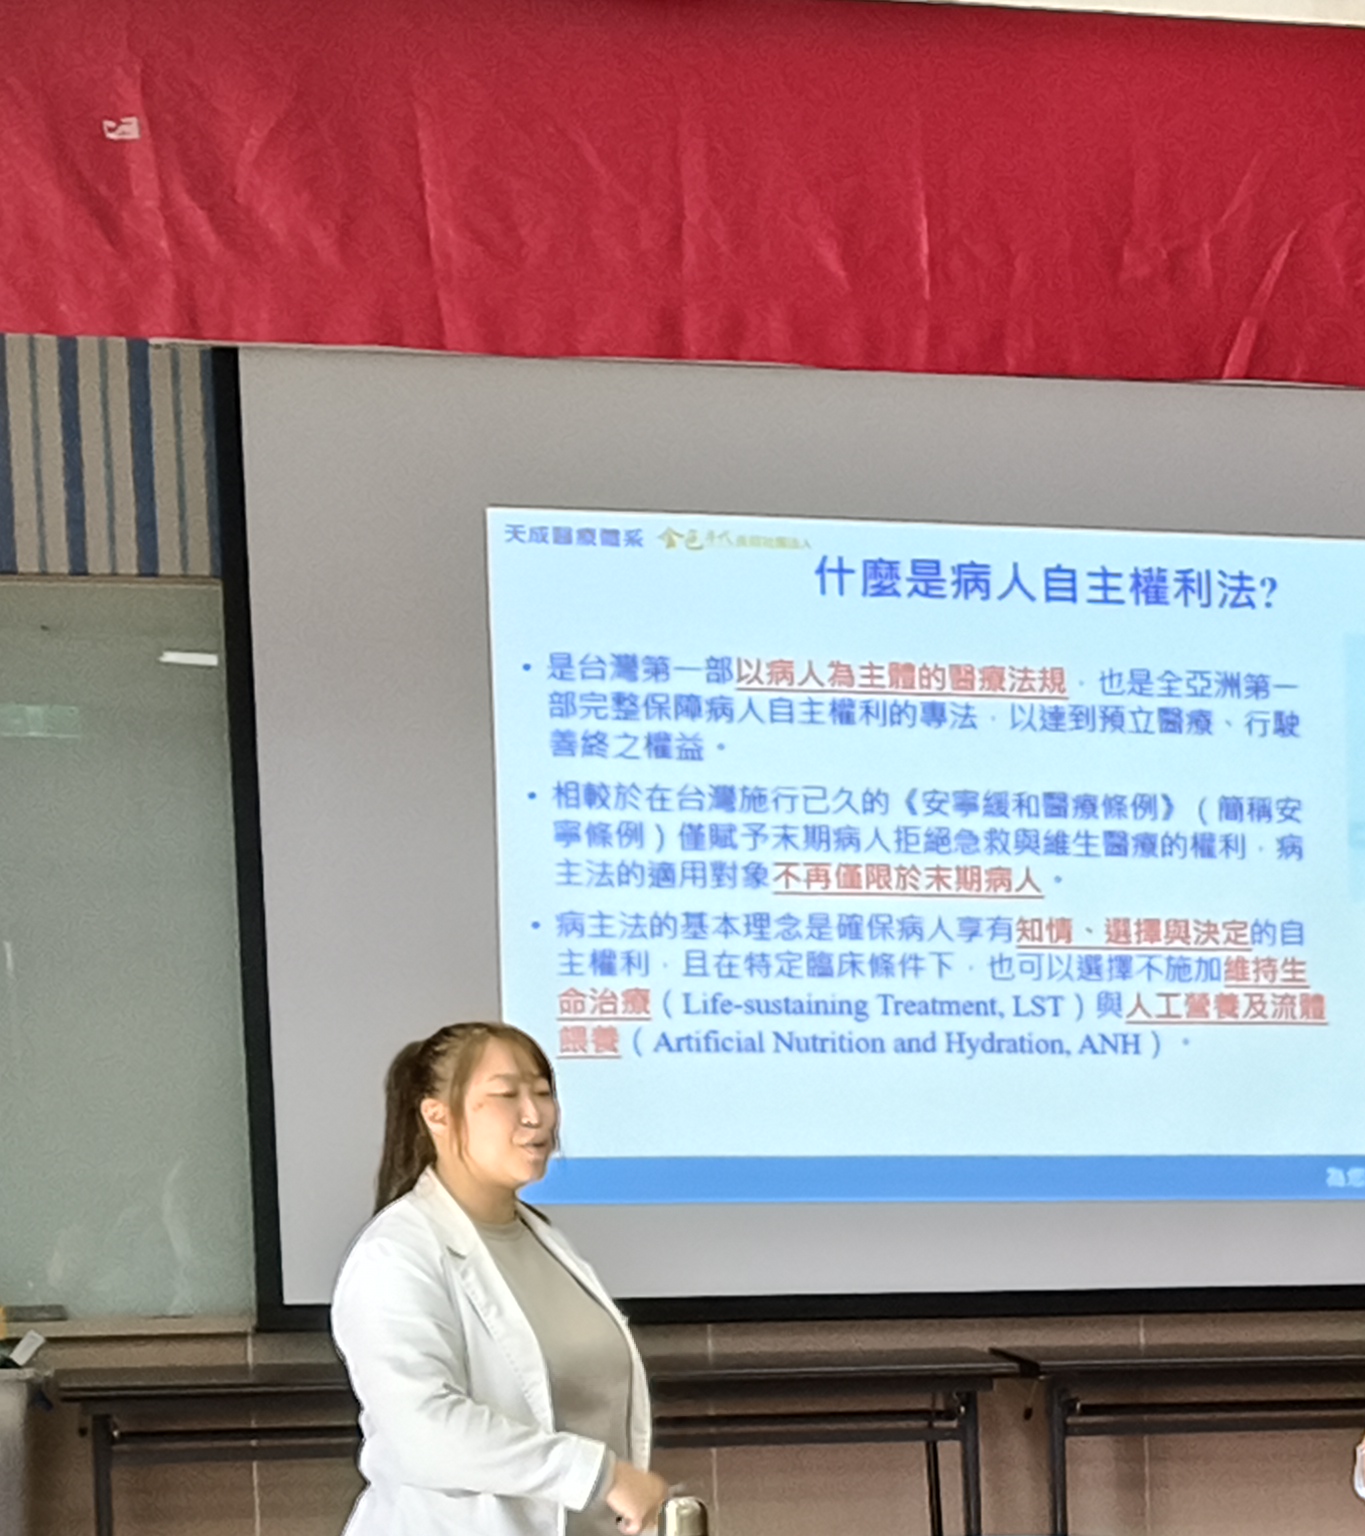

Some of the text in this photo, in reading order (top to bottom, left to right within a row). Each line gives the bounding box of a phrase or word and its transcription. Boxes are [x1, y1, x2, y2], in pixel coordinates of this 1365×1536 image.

[814, 555, 1278, 609] 什麼是病人自主權利法?
[550, 729, 726, 762] 善終之權益。
[877, 993, 1005, 1019] Treatment,
[771, 1030, 886, 1054] Nutrition
[893, 1031, 937, 1054] and
[945, 1031, 1071, 1060] Hydration,
